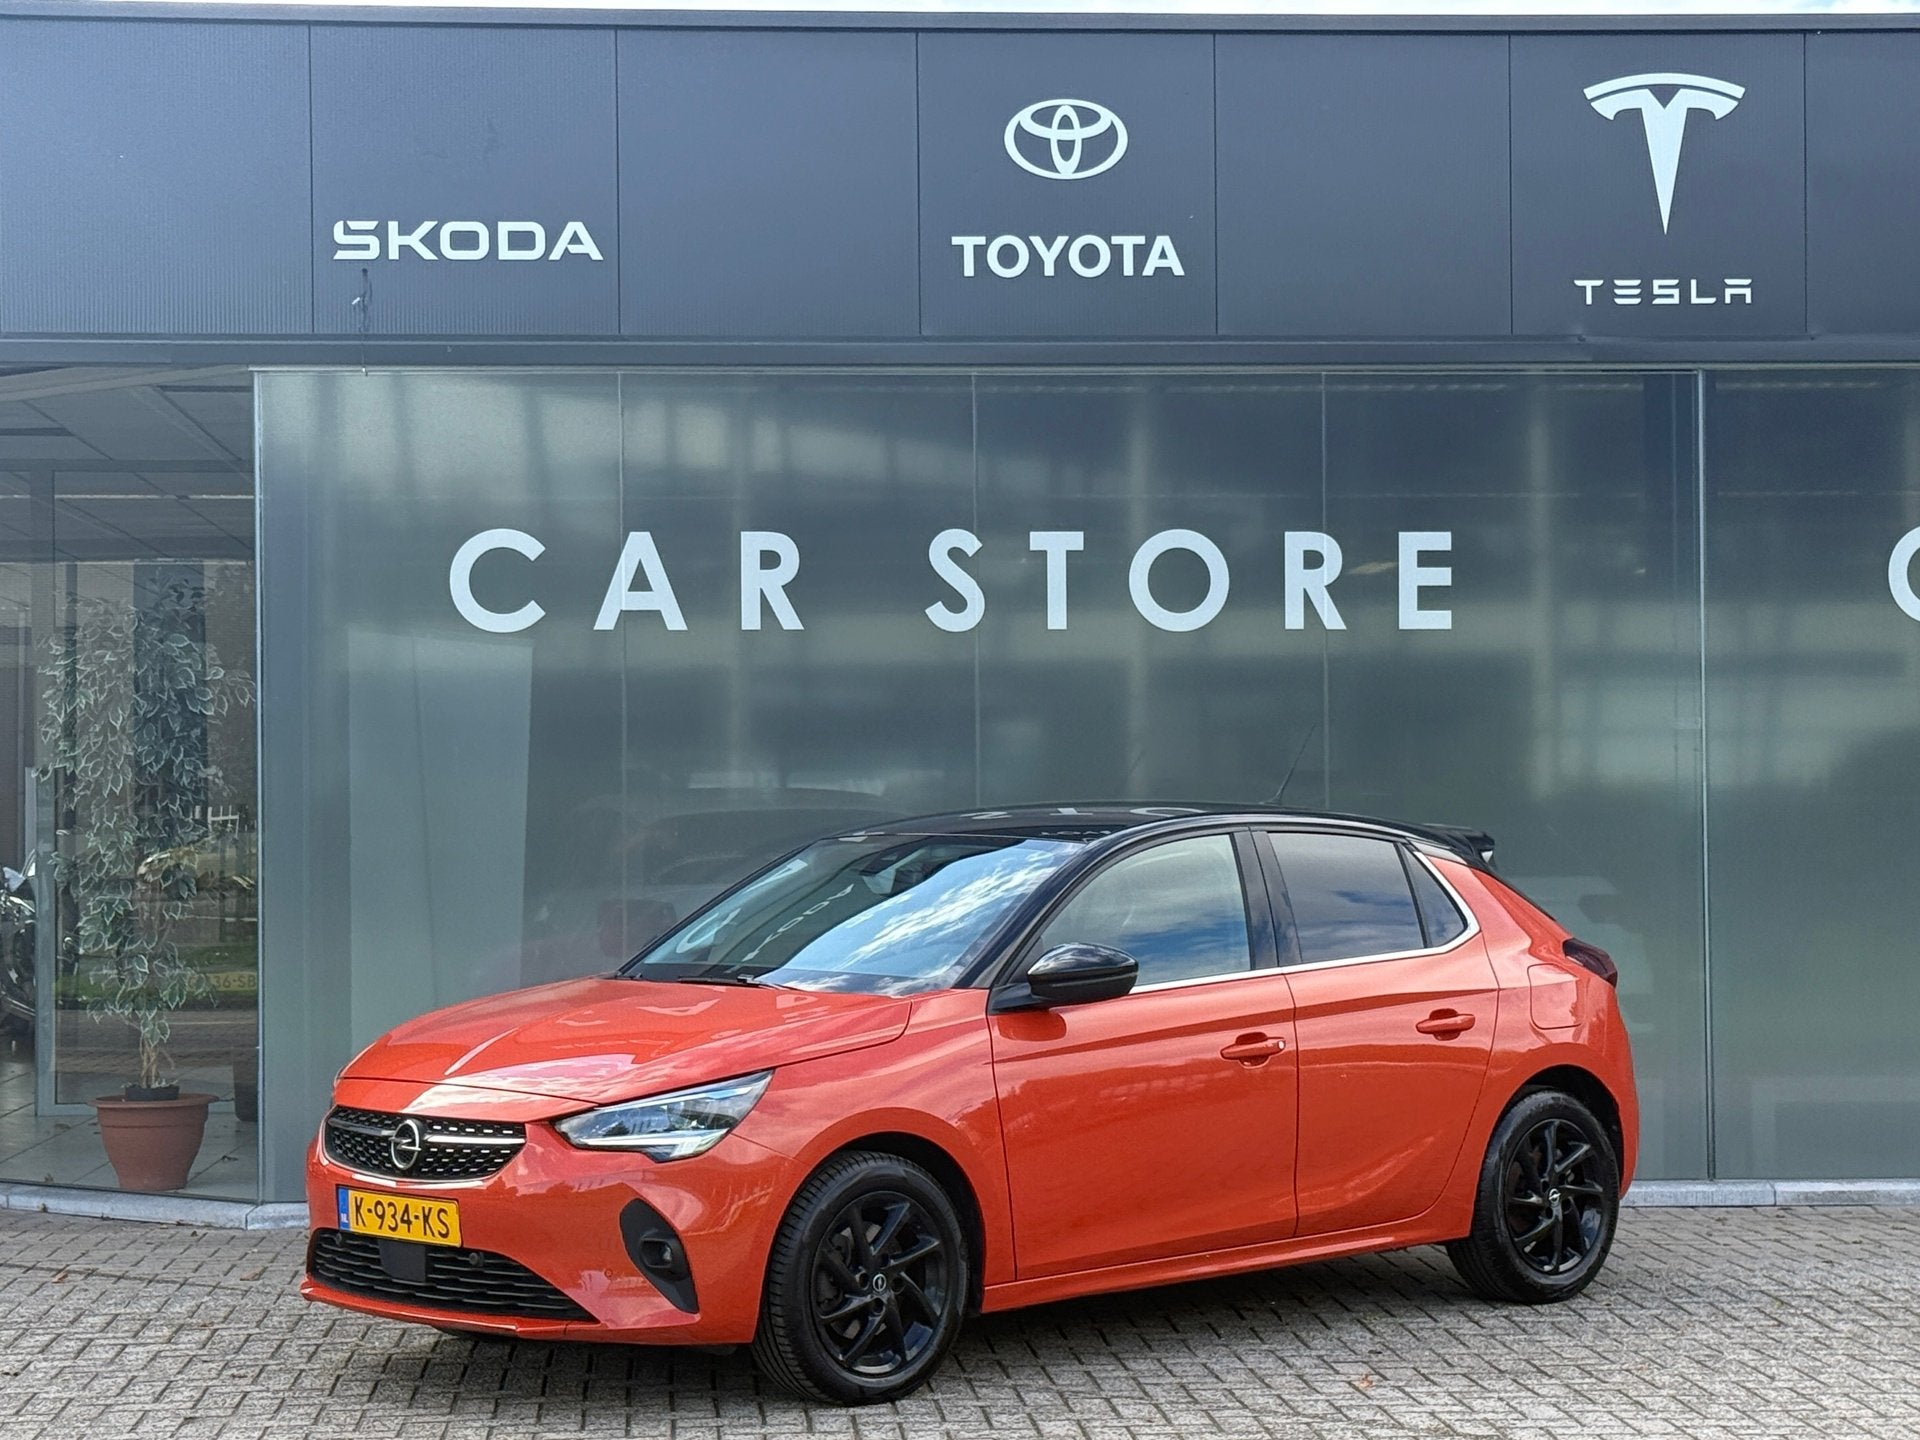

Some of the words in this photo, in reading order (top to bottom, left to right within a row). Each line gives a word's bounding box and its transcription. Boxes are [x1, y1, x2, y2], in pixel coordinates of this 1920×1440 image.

[333, 220, 604, 261] SKODA
[951, 234, 1185, 278] TOYOTA
[1573, 278, 1753, 305] TESLA
[449, 528, 804, 634] CAR
[924, 527, 1453, 634] STORE
[354, 1196, 450, 1239] K-934-KS
